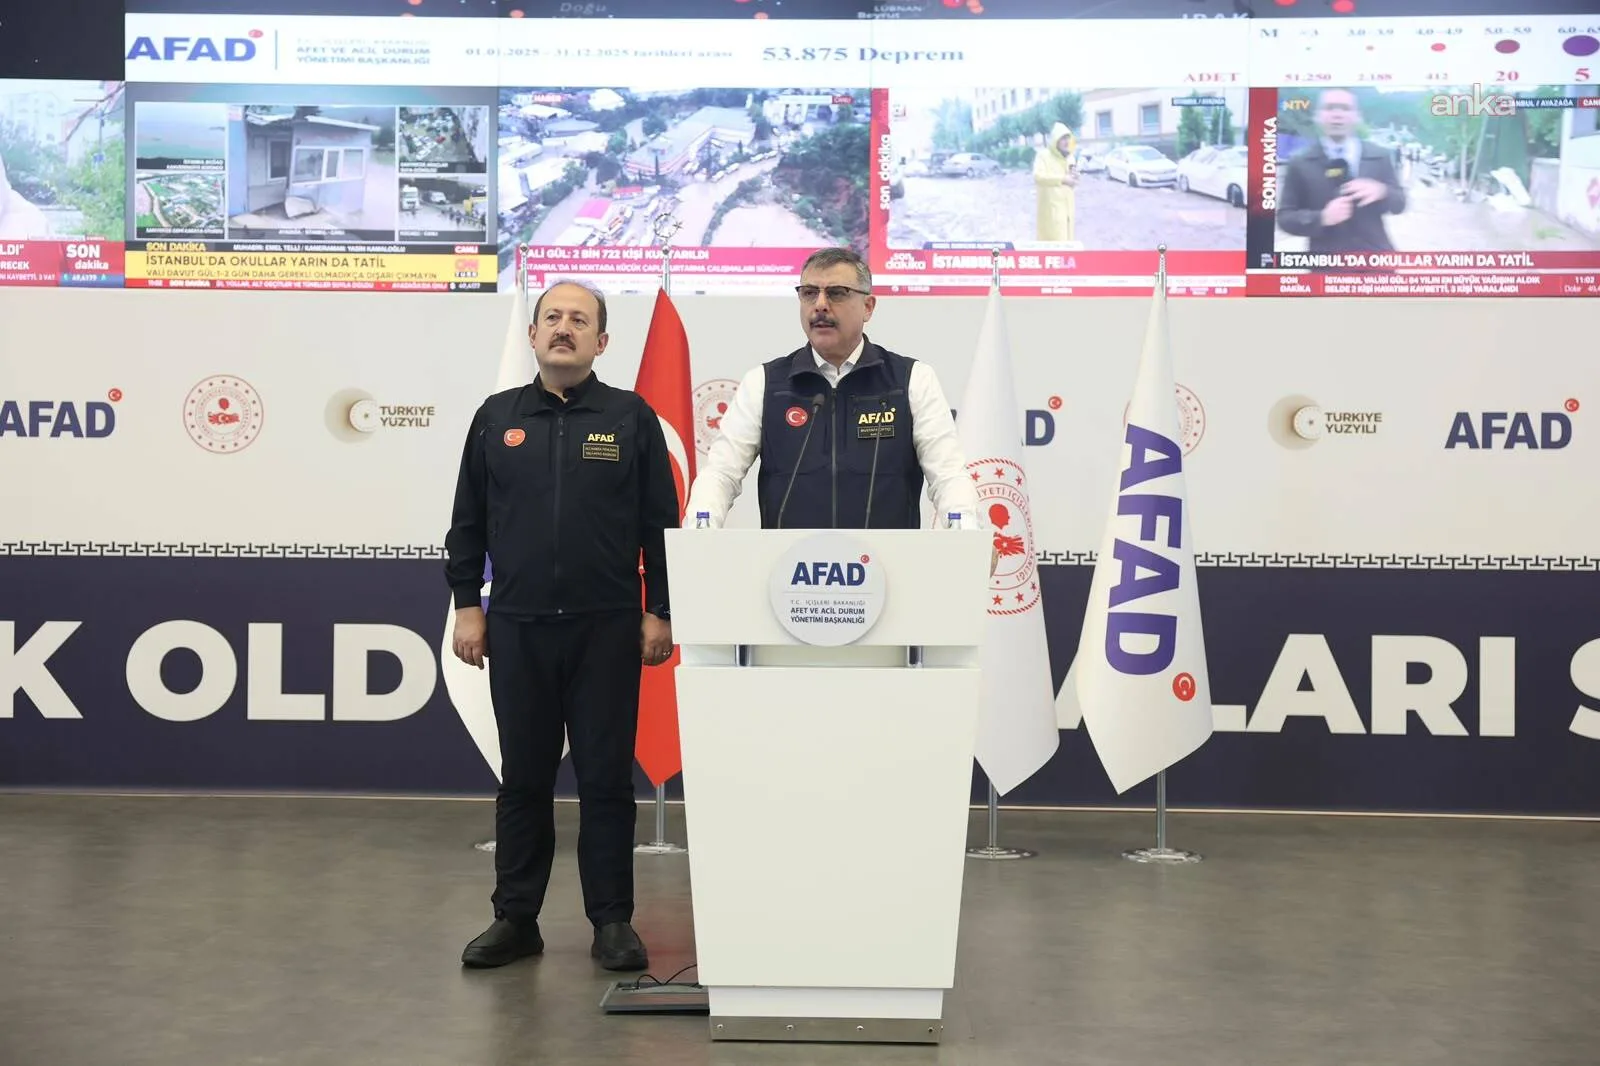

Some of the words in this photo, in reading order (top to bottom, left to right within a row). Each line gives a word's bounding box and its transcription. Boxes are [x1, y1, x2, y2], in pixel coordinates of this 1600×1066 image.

[1260, 28, 1278, 38] M
[126, 36, 256, 61] AFAD
[762, 47, 848, 61] 53.875
[858, 47, 964, 64] Deprem
[1184, 72, 1240, 82] ADET
[1496, 71, 1519, 81] 20
[1575, 68, 1590, 82] 5
[1283, 100, 1309, 110] NTV
[1260, 116, 1278, 174] DAKİKA
[878, 134, 891, 181] dakika
[880, 185, 890, 210] son
[1262, 177, 1276, 210] SON
[66, 244, 100, 258] SON
[146, 242, 167, 251] SON
[169, 241, 206, 251] DAKİKA
[146, 252, 226, 266] İSTANBUL'DA
[230, 255, 287, 266] OKULLAR
[290, 256, 328, 267] YARIN
[332, 257, 349, 267] DA
[353, 255, 386, 268] TATİL
[645, 249, 709, 260] KUTARILDI
[932, 254, 1015, 269] İSTANBULDA
[1018, 255, 1042, 269] SEL
[1280, 251, 1367, 267] İSTANBUL'DA
[1369, 254, 1432, 267] OKULLAR
[1435, 254, 1474, 267] YARIN
[1477, 255, 1496, 267] DA
[1498, 251, 1534, 267] TATİL
[74, 260, 109, 270] dakika
[0, 401, 116, 437] AFAD
[858, 411, 894, 424] AFAD
[587, 433, 615, 443] AFAD
[1444, 411, 1573, 450] AFAD
[1105, 423, 1183, 675] AFAD
[791, 561, 866, 586] AFAD
[820, 606, 836, 614] ACİL
[791, 615, 823, 623] YÖNETİMİ
[824, 616, 865, 624] BAŞKANLIĞI
